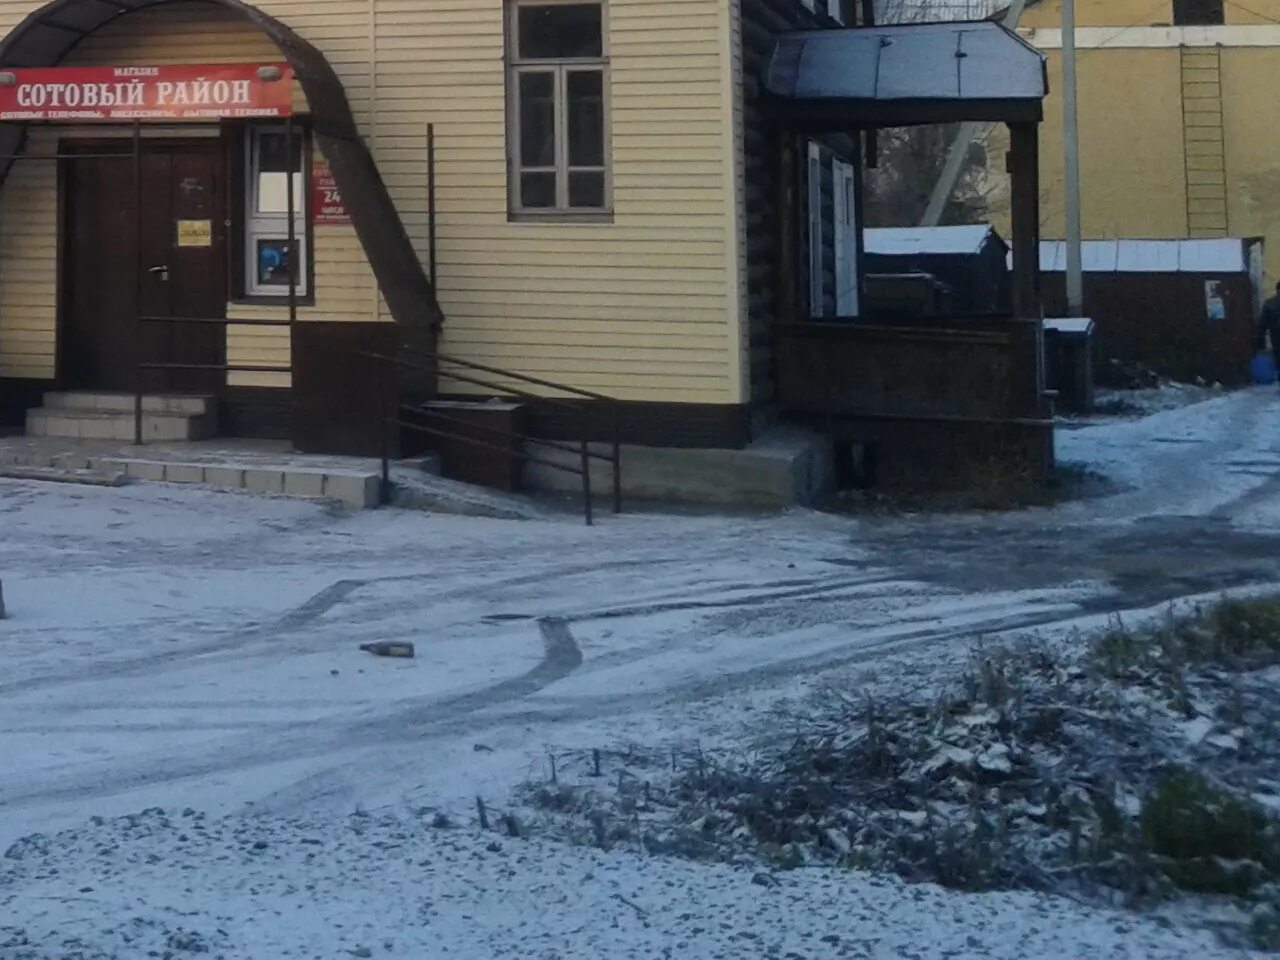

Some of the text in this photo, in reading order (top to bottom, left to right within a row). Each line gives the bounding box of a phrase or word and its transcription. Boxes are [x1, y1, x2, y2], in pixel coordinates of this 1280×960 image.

[113, 67, 159, 77] МАГАЗИН
[17, 77, 251, 107] СОТОВЫЙ РАЙОН
[323, 190, 341, 203] 24
